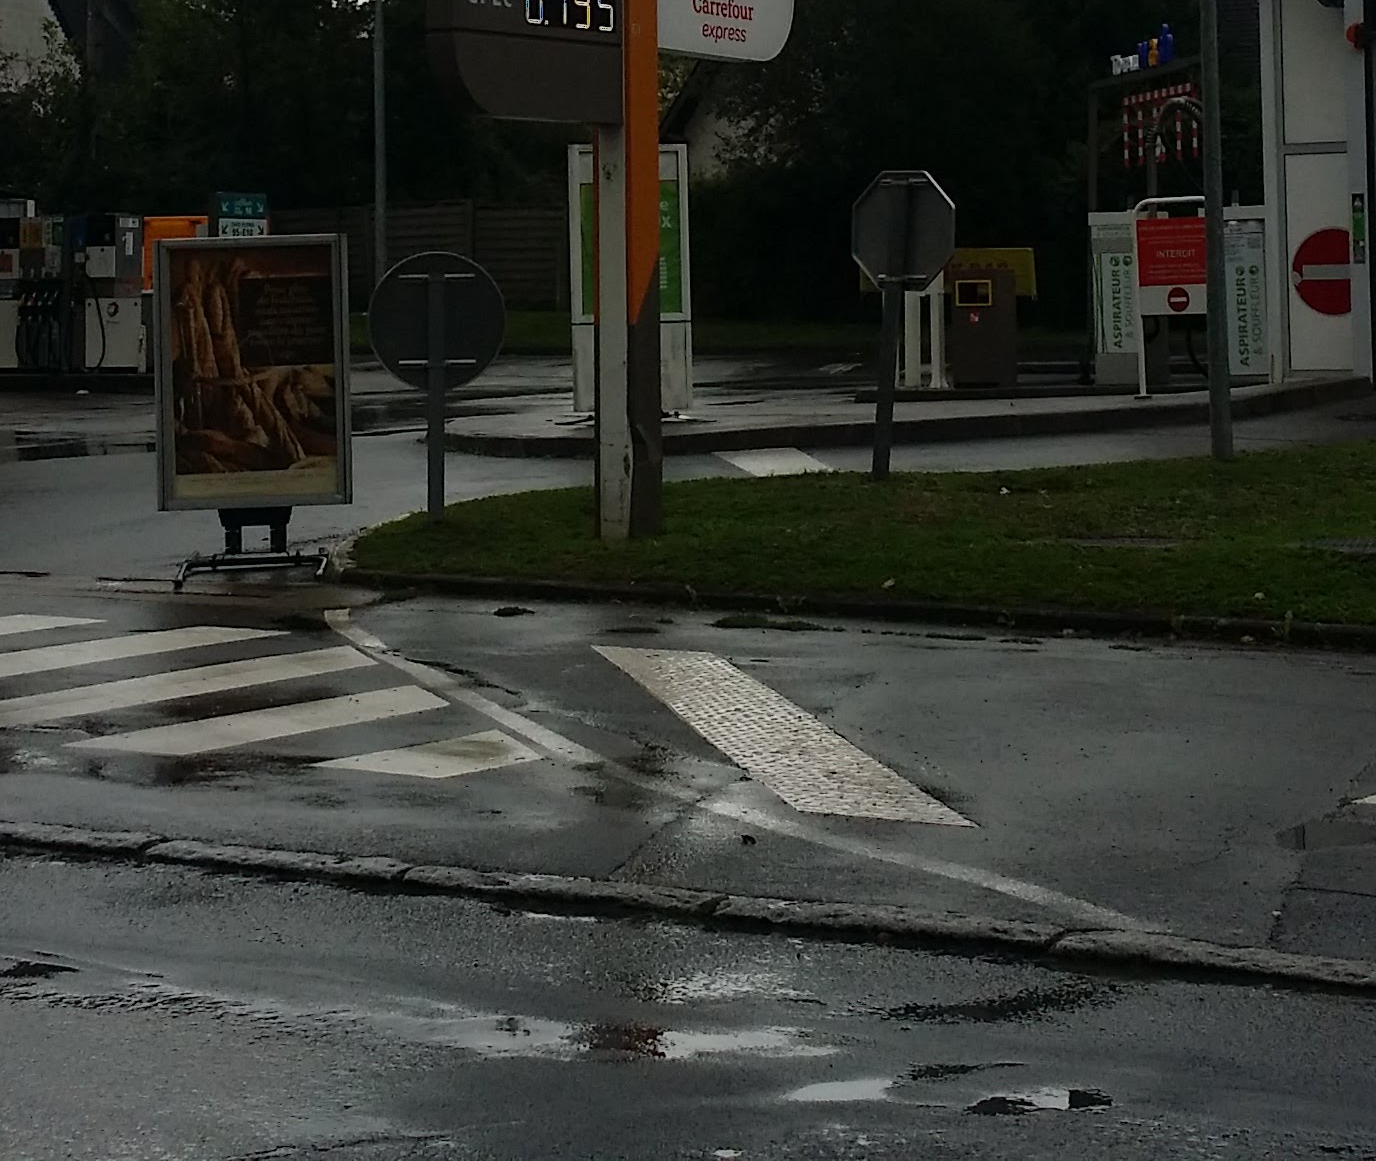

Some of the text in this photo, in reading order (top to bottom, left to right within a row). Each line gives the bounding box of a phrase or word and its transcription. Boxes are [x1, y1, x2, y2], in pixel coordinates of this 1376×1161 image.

[702, 22, 747, 43] express
[1156, 249, 1196, 259] INTERDIT
[1111, 268, 1123, 349] ASPIRATEUR
[1236, 277, 1250, 367] ASPIRATEUR
